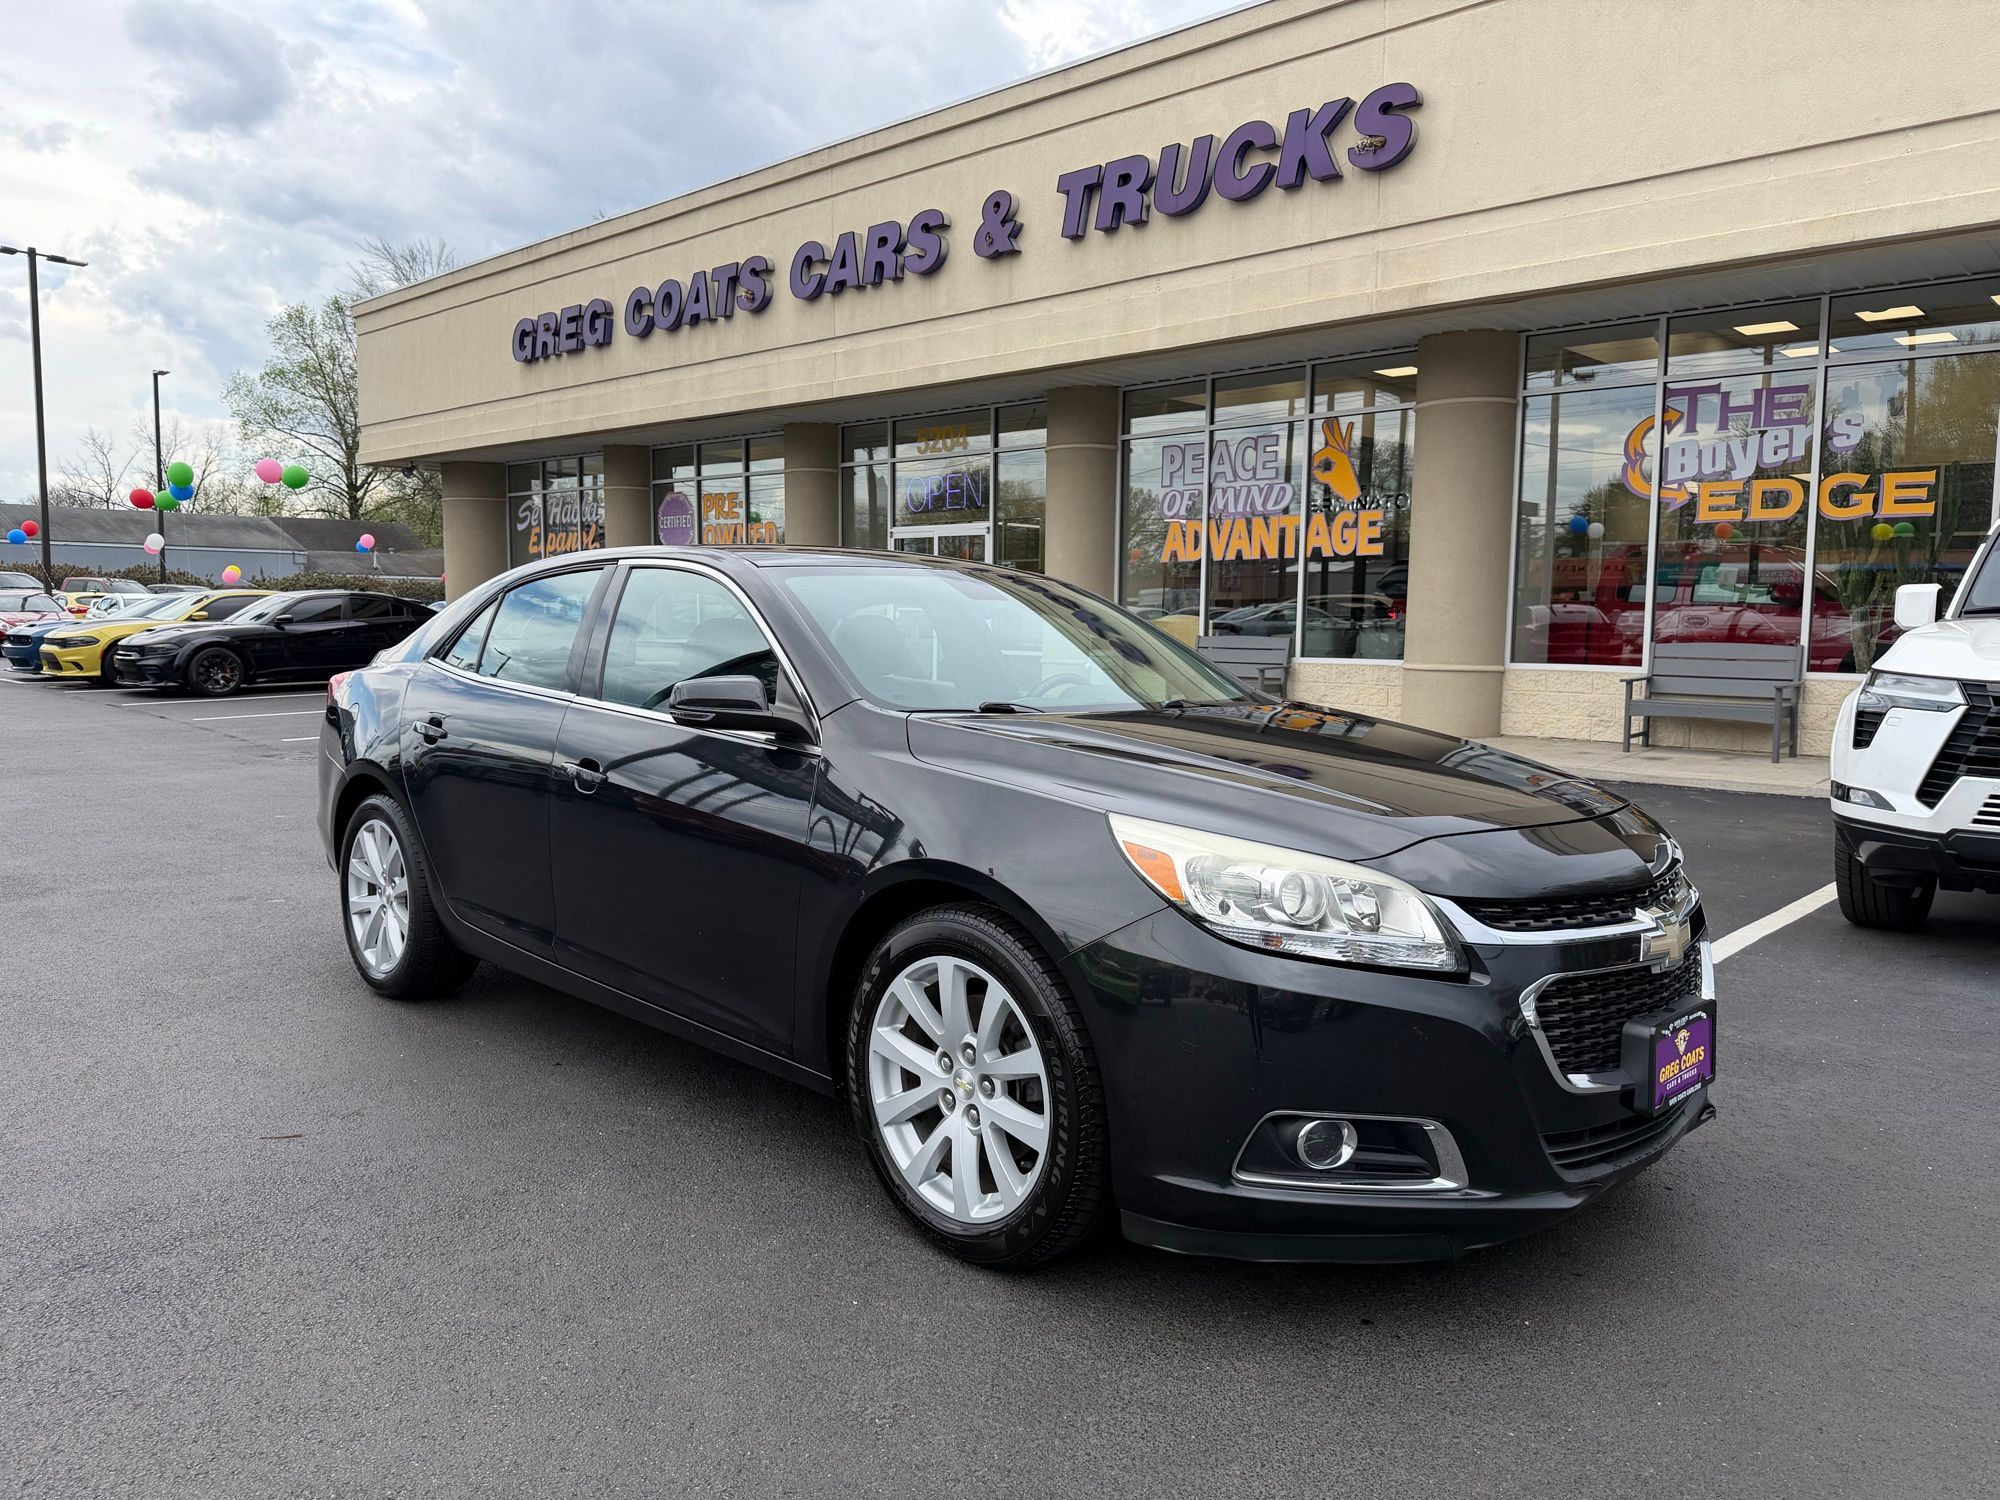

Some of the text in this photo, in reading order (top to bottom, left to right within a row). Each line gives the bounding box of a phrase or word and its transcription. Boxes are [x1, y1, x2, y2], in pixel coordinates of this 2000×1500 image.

[512, 82, 1424, 363] GREG COATS CARS & TRUCKS
[1667, 382, 1808, 436] THE
[916, 424, 969, 454] 5204
[1161, 434, 1279, 488] PEACE
[702, 492, 744, 521] PRE-
[906, 471, 984, 513] OPEN
[1161, 482, 1294, 518] OF MIND
[1694, 470, 1937, 524] EDGE
[517, 500, 541, 531] Se
[660, 515, 692, 529] CERTIFIED
[1160, 509, 1385, 563] ADVANTAGE
[1660, 1046, 1705, 1083] GREG COATS
[1666, 1078, 1677, 1090] CARS
[1682, 1067, 1697, 1081] TRUCKS
